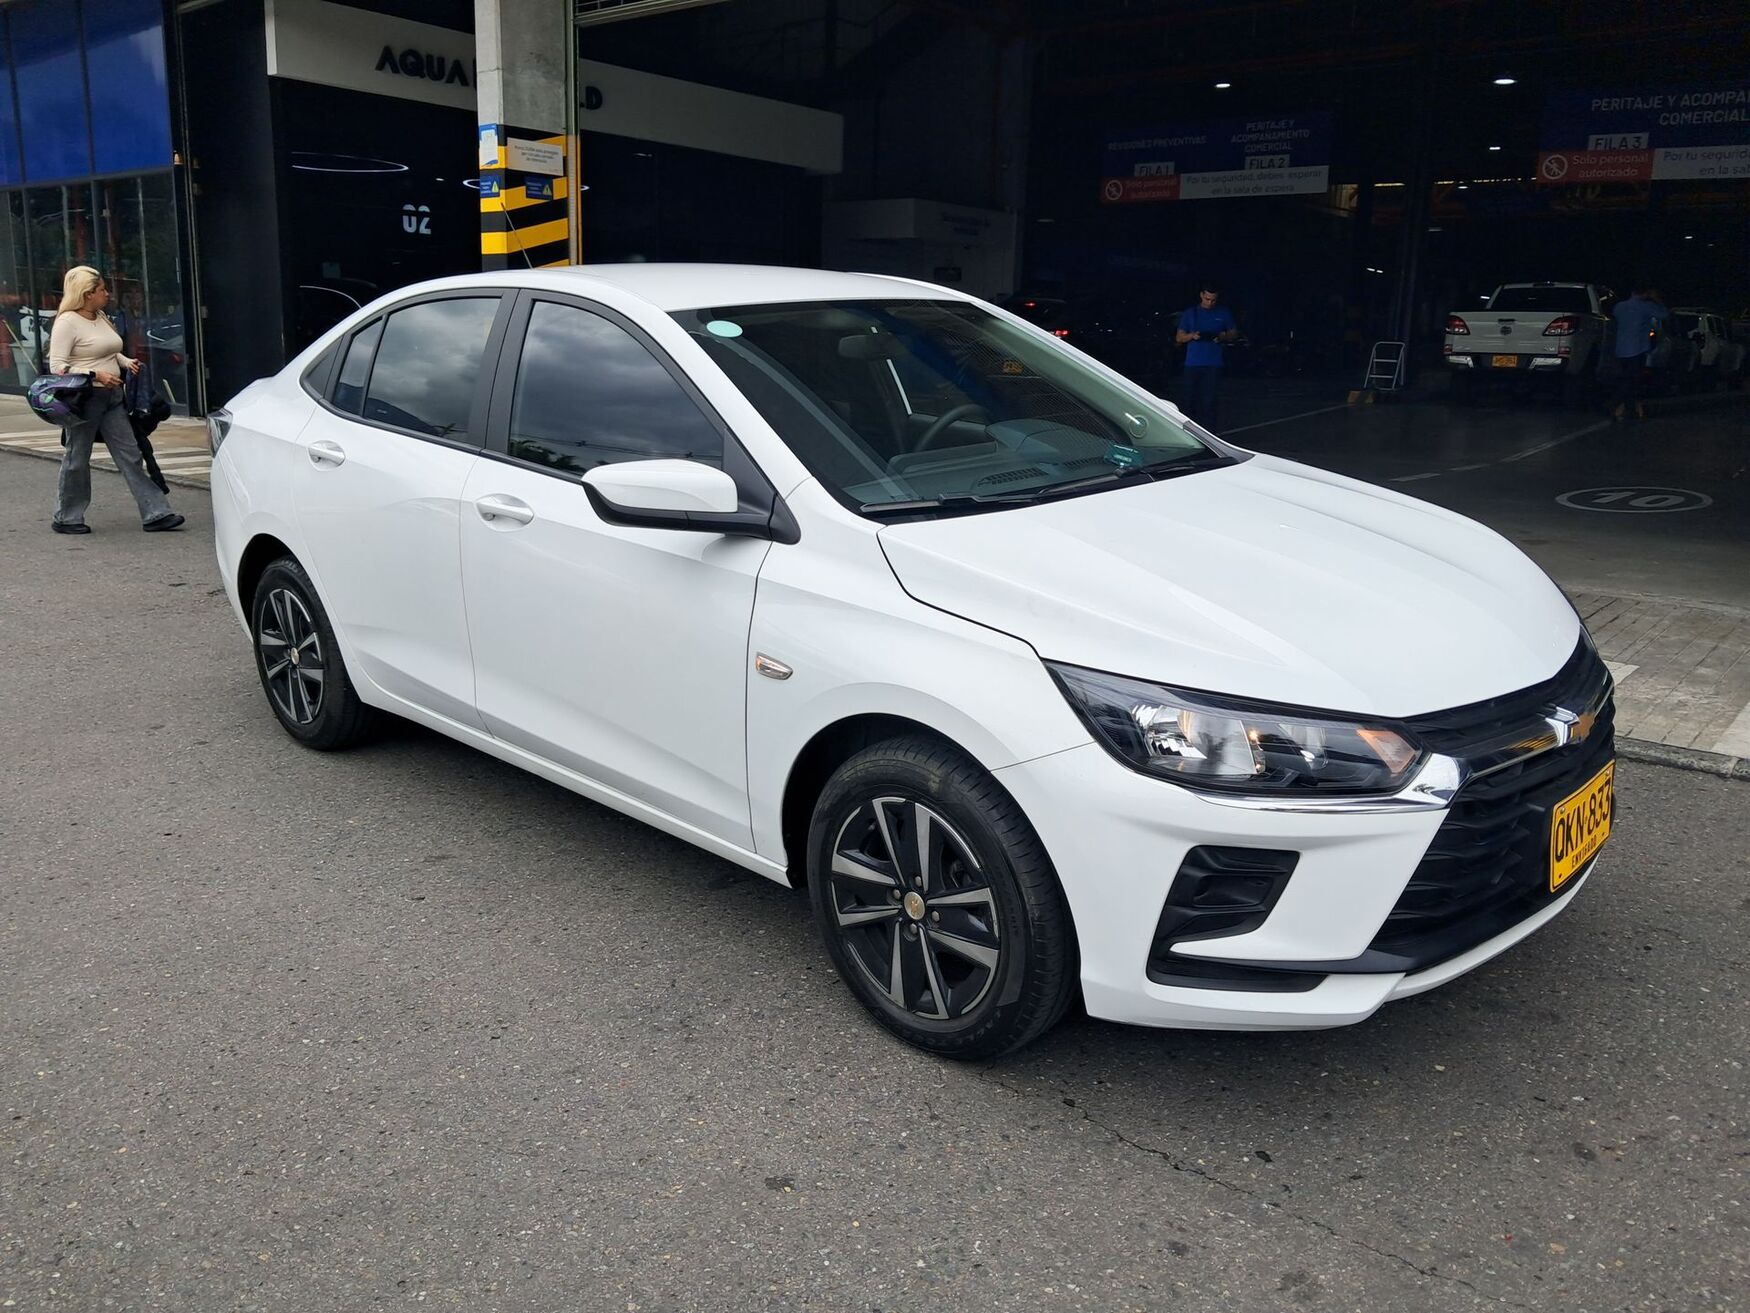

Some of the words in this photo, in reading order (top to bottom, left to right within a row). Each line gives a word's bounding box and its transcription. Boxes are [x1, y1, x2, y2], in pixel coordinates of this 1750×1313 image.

[1591, 96, 1663, 111] PERITAJE
[1667, 95, 1678, 107] Y
[1659, 108, 1750, 126] COMERCIAL
[1244, 142, 1293, 153] COMERCIAL
[1594, 137, 1628, 150] FILA
[1632, 136, 1641, 149] 3
[1572, 154, 1597, 166] Solo
[1599, 152, 1649, 166] personal
[1664, 151, 1682, 162] Por
[1686, 151, 1697, 161] tu
[1249, 158, 1275, 170] FILA
[1278, 157, 1285, 168] 2
[1699, 167, 1715, 176] en
[1718, 164, 1729, 175] la
[1139, 165, 1162, 177] FILA
[1579, 165, 1639, 178] autorizado
[402, 203, 432, 235] 02
